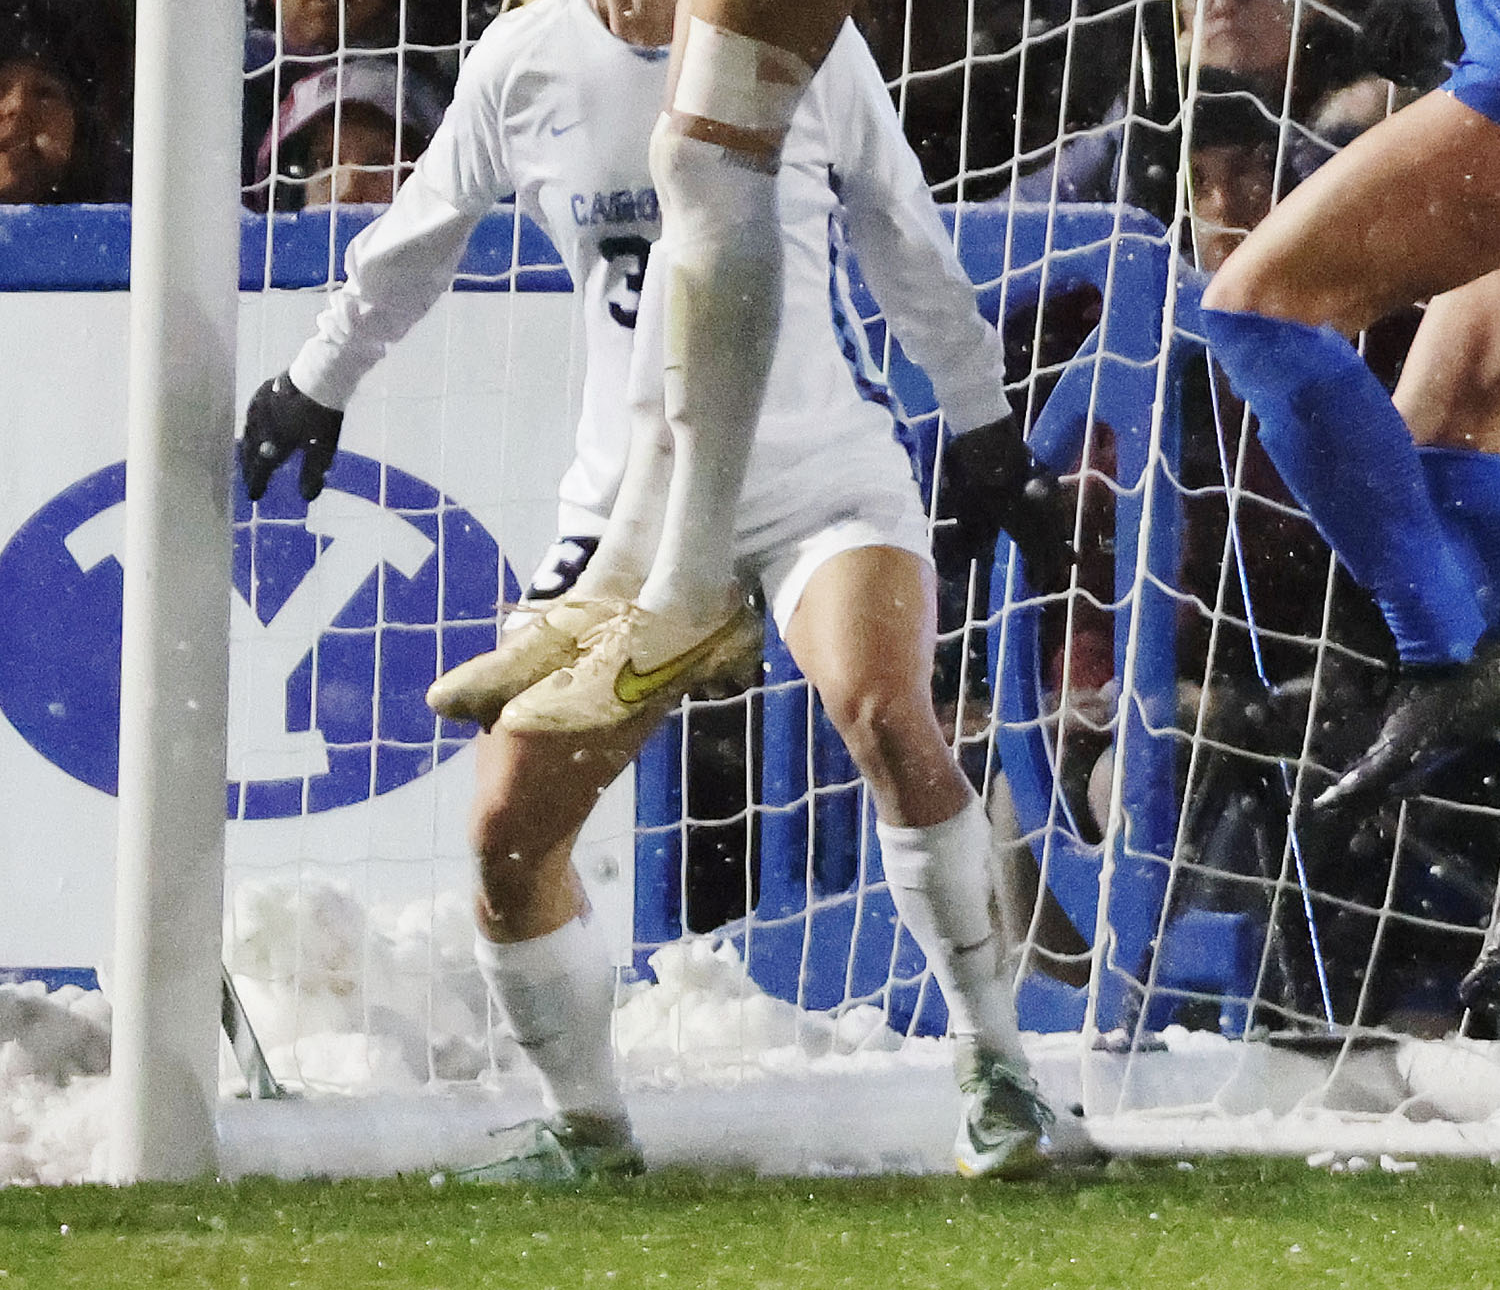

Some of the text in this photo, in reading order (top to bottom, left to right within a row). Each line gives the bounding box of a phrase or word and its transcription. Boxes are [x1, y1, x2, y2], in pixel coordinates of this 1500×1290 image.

[598, 235, 651, 329] 3
[525, 536, 602, 600] 3
[64, 488, 436, 782] Y
